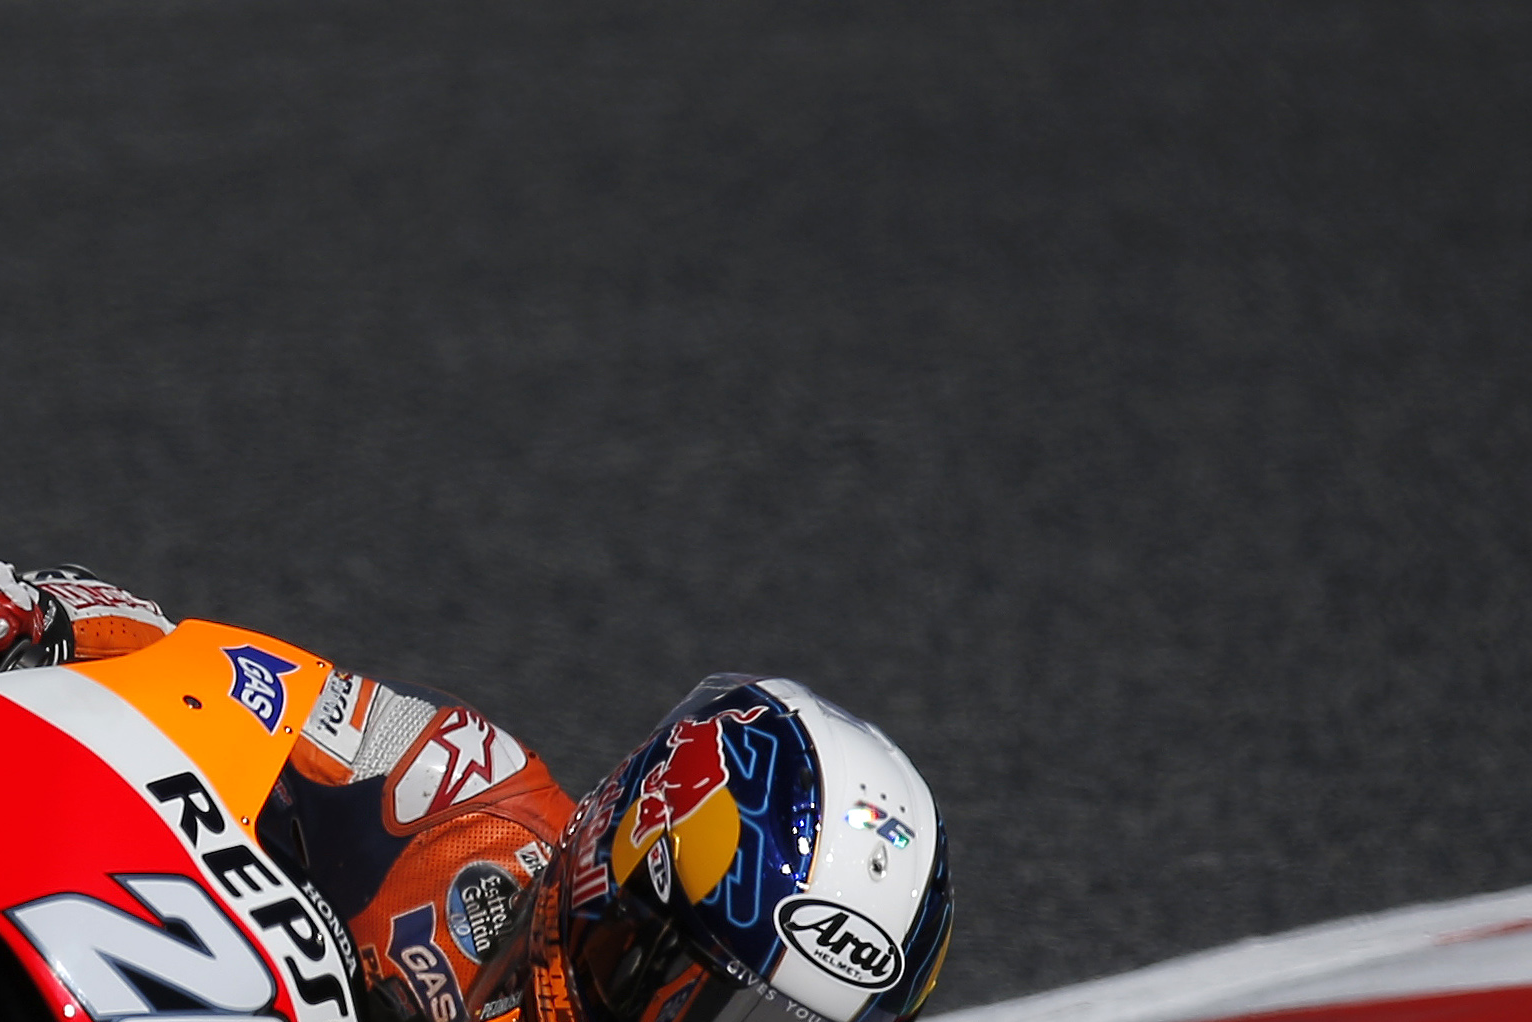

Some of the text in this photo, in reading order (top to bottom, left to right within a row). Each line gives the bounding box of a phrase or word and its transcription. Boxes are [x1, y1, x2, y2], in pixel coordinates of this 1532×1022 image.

[237, 656, 276, 719] GAS
[301, 881, 357, 979] HONDA
[783, 912, 896, 977] Arai
[726, 960, 778, 1001] GIVES
